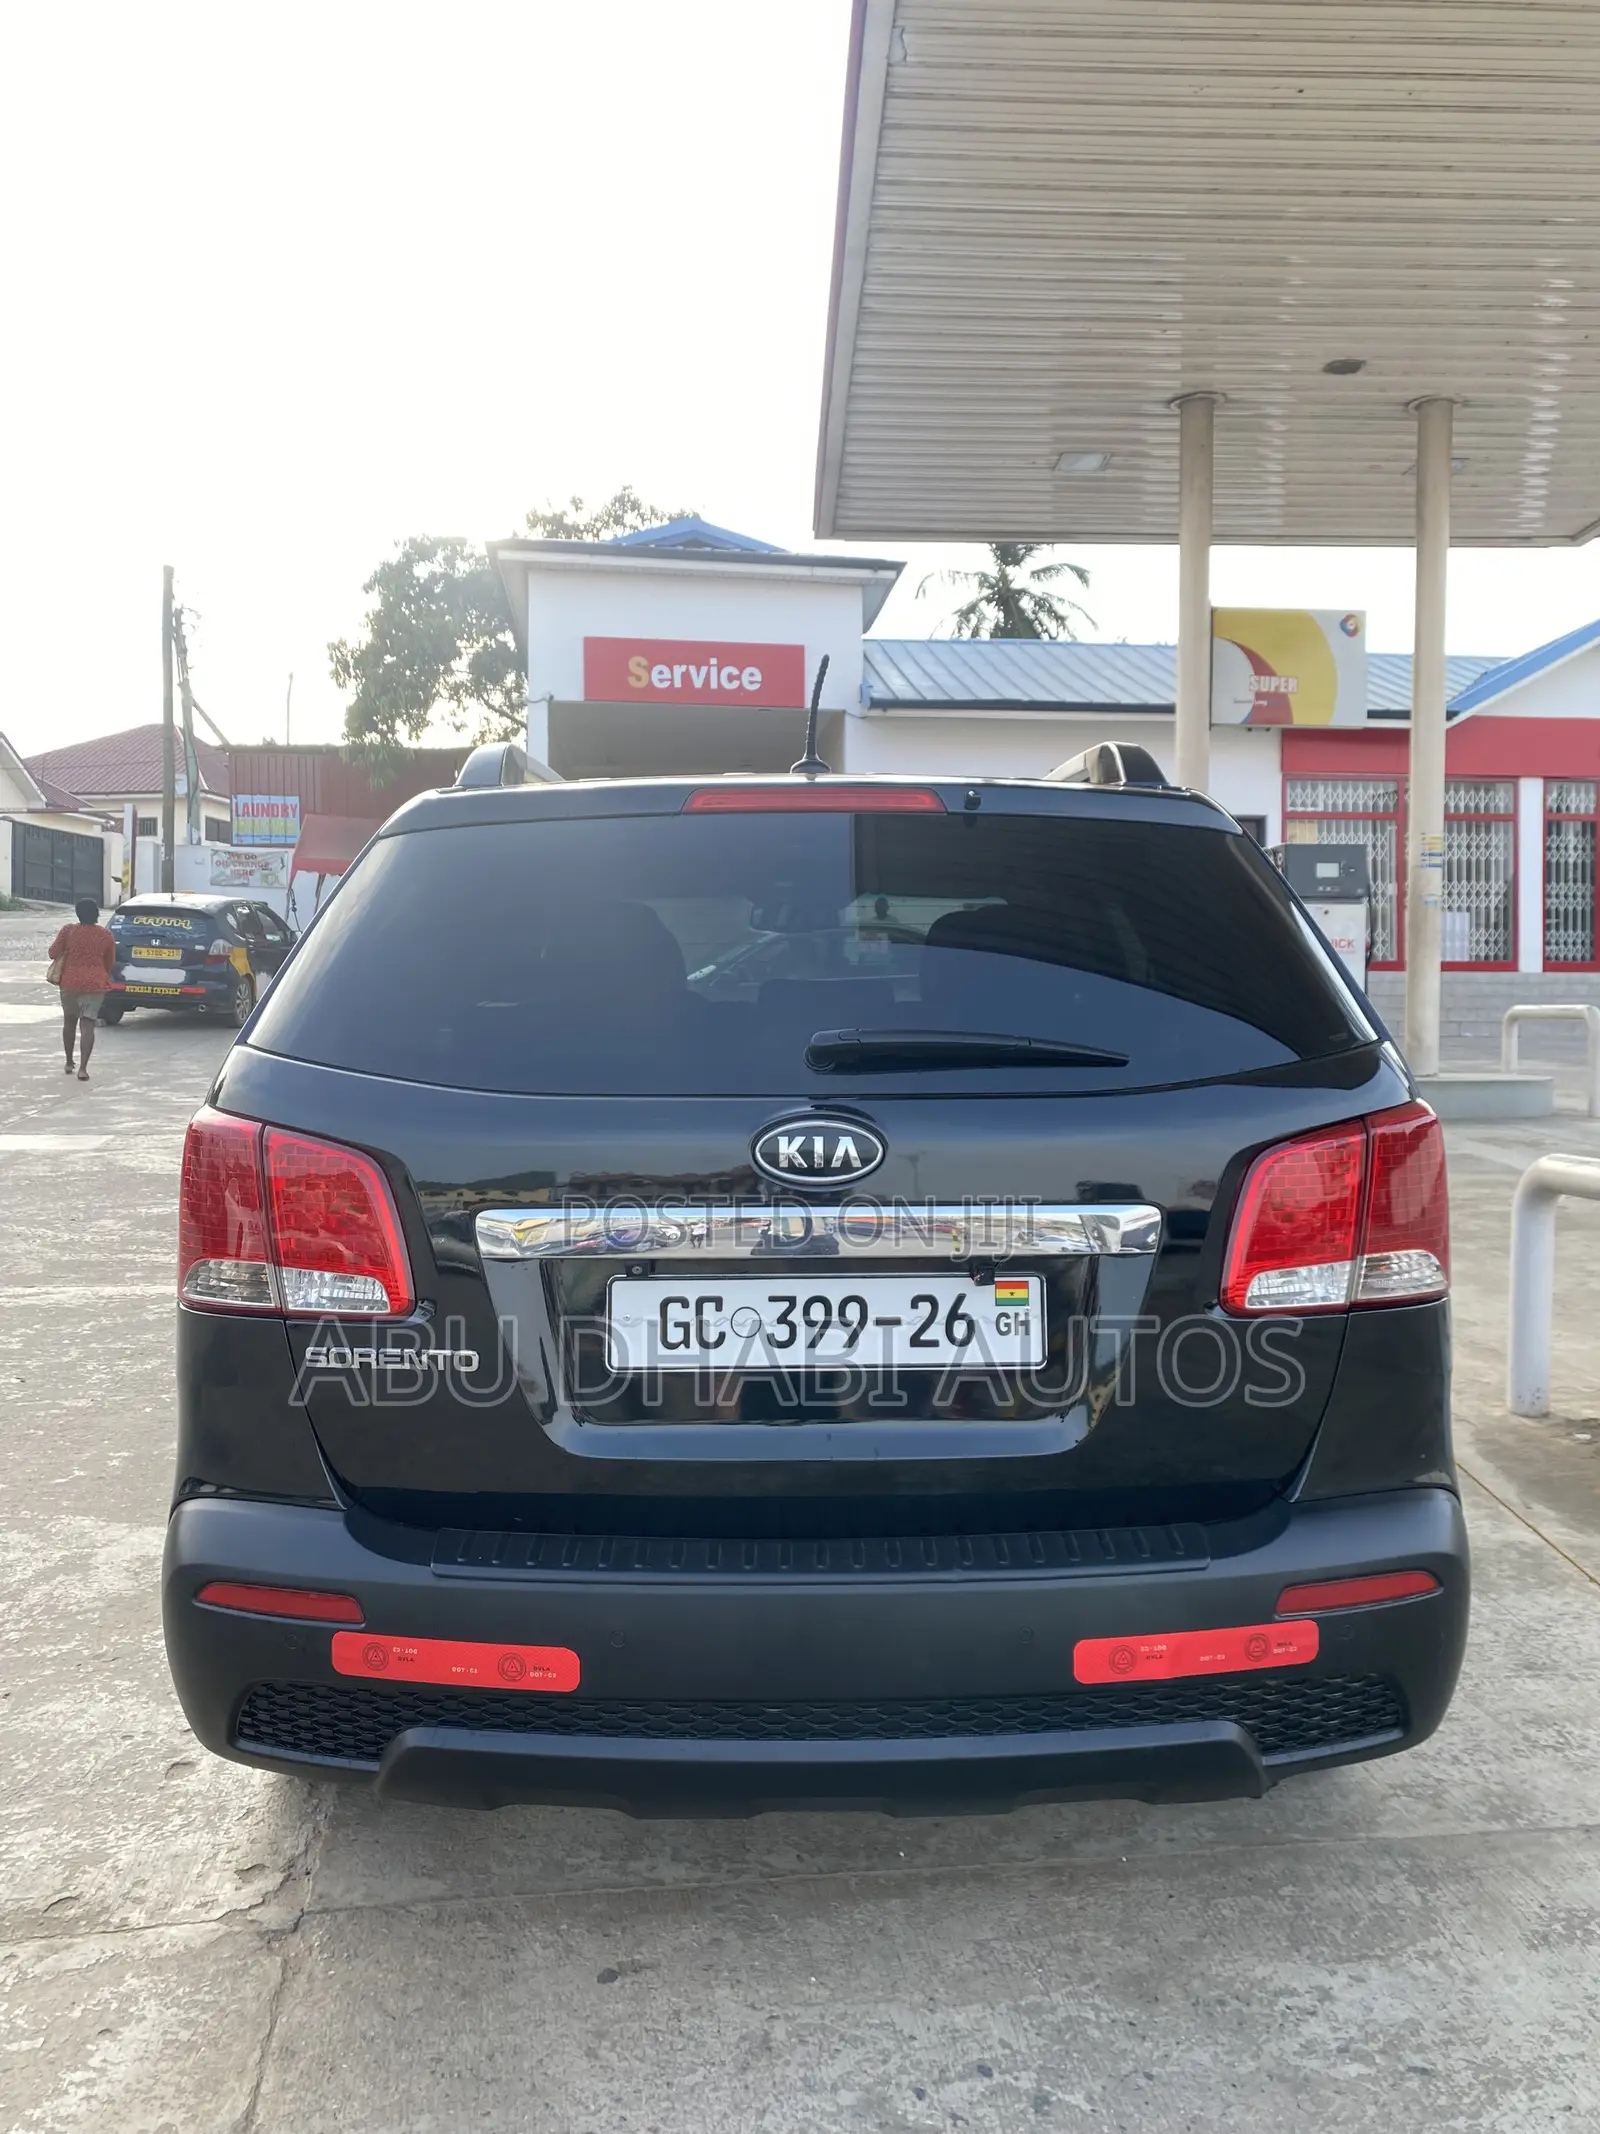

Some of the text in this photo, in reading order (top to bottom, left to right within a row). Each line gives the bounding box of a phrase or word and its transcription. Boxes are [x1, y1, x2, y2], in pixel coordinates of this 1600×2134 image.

[627, 656, 762, 691] Service
[1249, 675, 1298, 693] SUPER
[234, 802, 298, 819] LAUNDRY
[1331, 938, 1357, 949] ICK
[777, 1135, 863, 1169] KIA
[659, 1293, 976, 1350] GC 399-26
[995, 1311, 1031, 1336] GH
[305, 1347, 480, 1372] SORENTO
